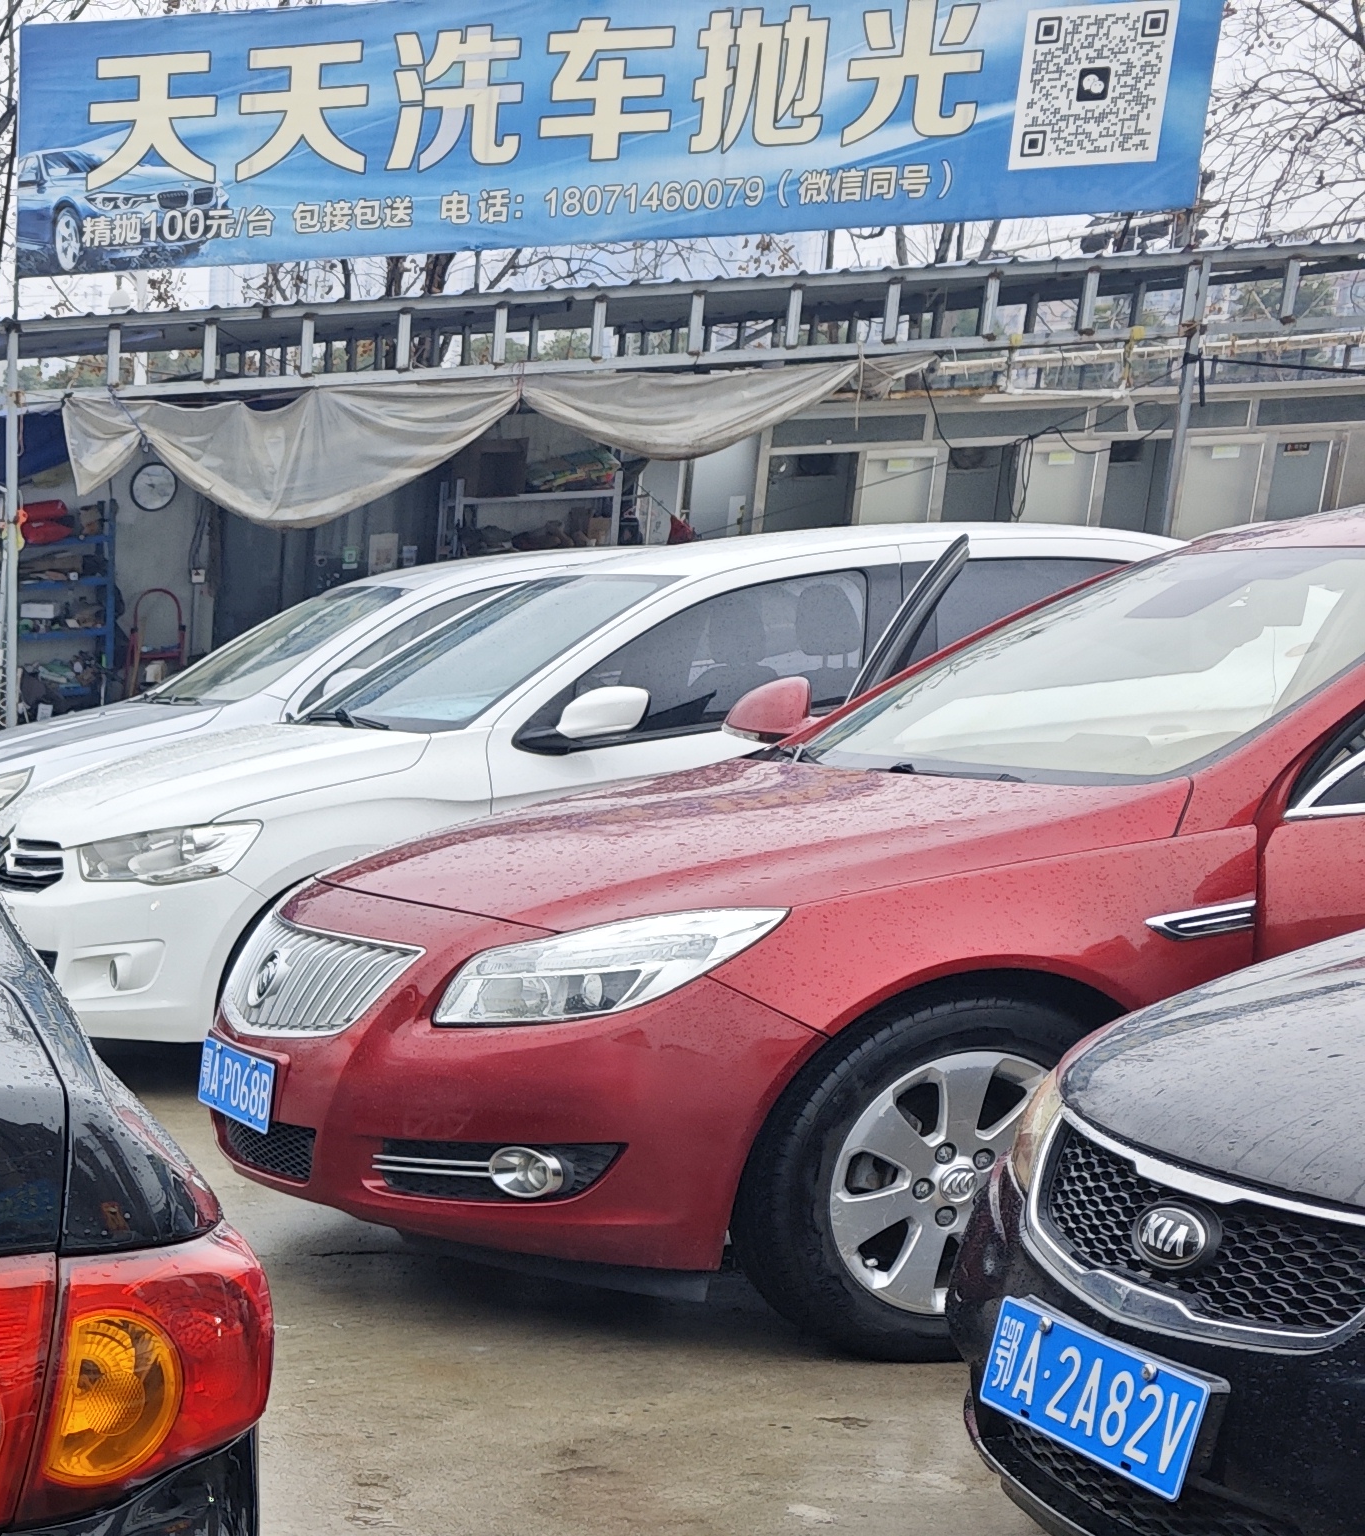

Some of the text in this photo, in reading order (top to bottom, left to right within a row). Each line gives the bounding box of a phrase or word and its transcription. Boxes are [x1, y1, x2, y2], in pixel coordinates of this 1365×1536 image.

[84, 0, 985, 193] 天天洗车抛光
[81, 203, 276, 249] 精抛100元/台
[293, 195, 414, 235] 包接包送
[543, 176, 766, 220] 18071460079
[1141, 1213, 1189, 1258] KIA
